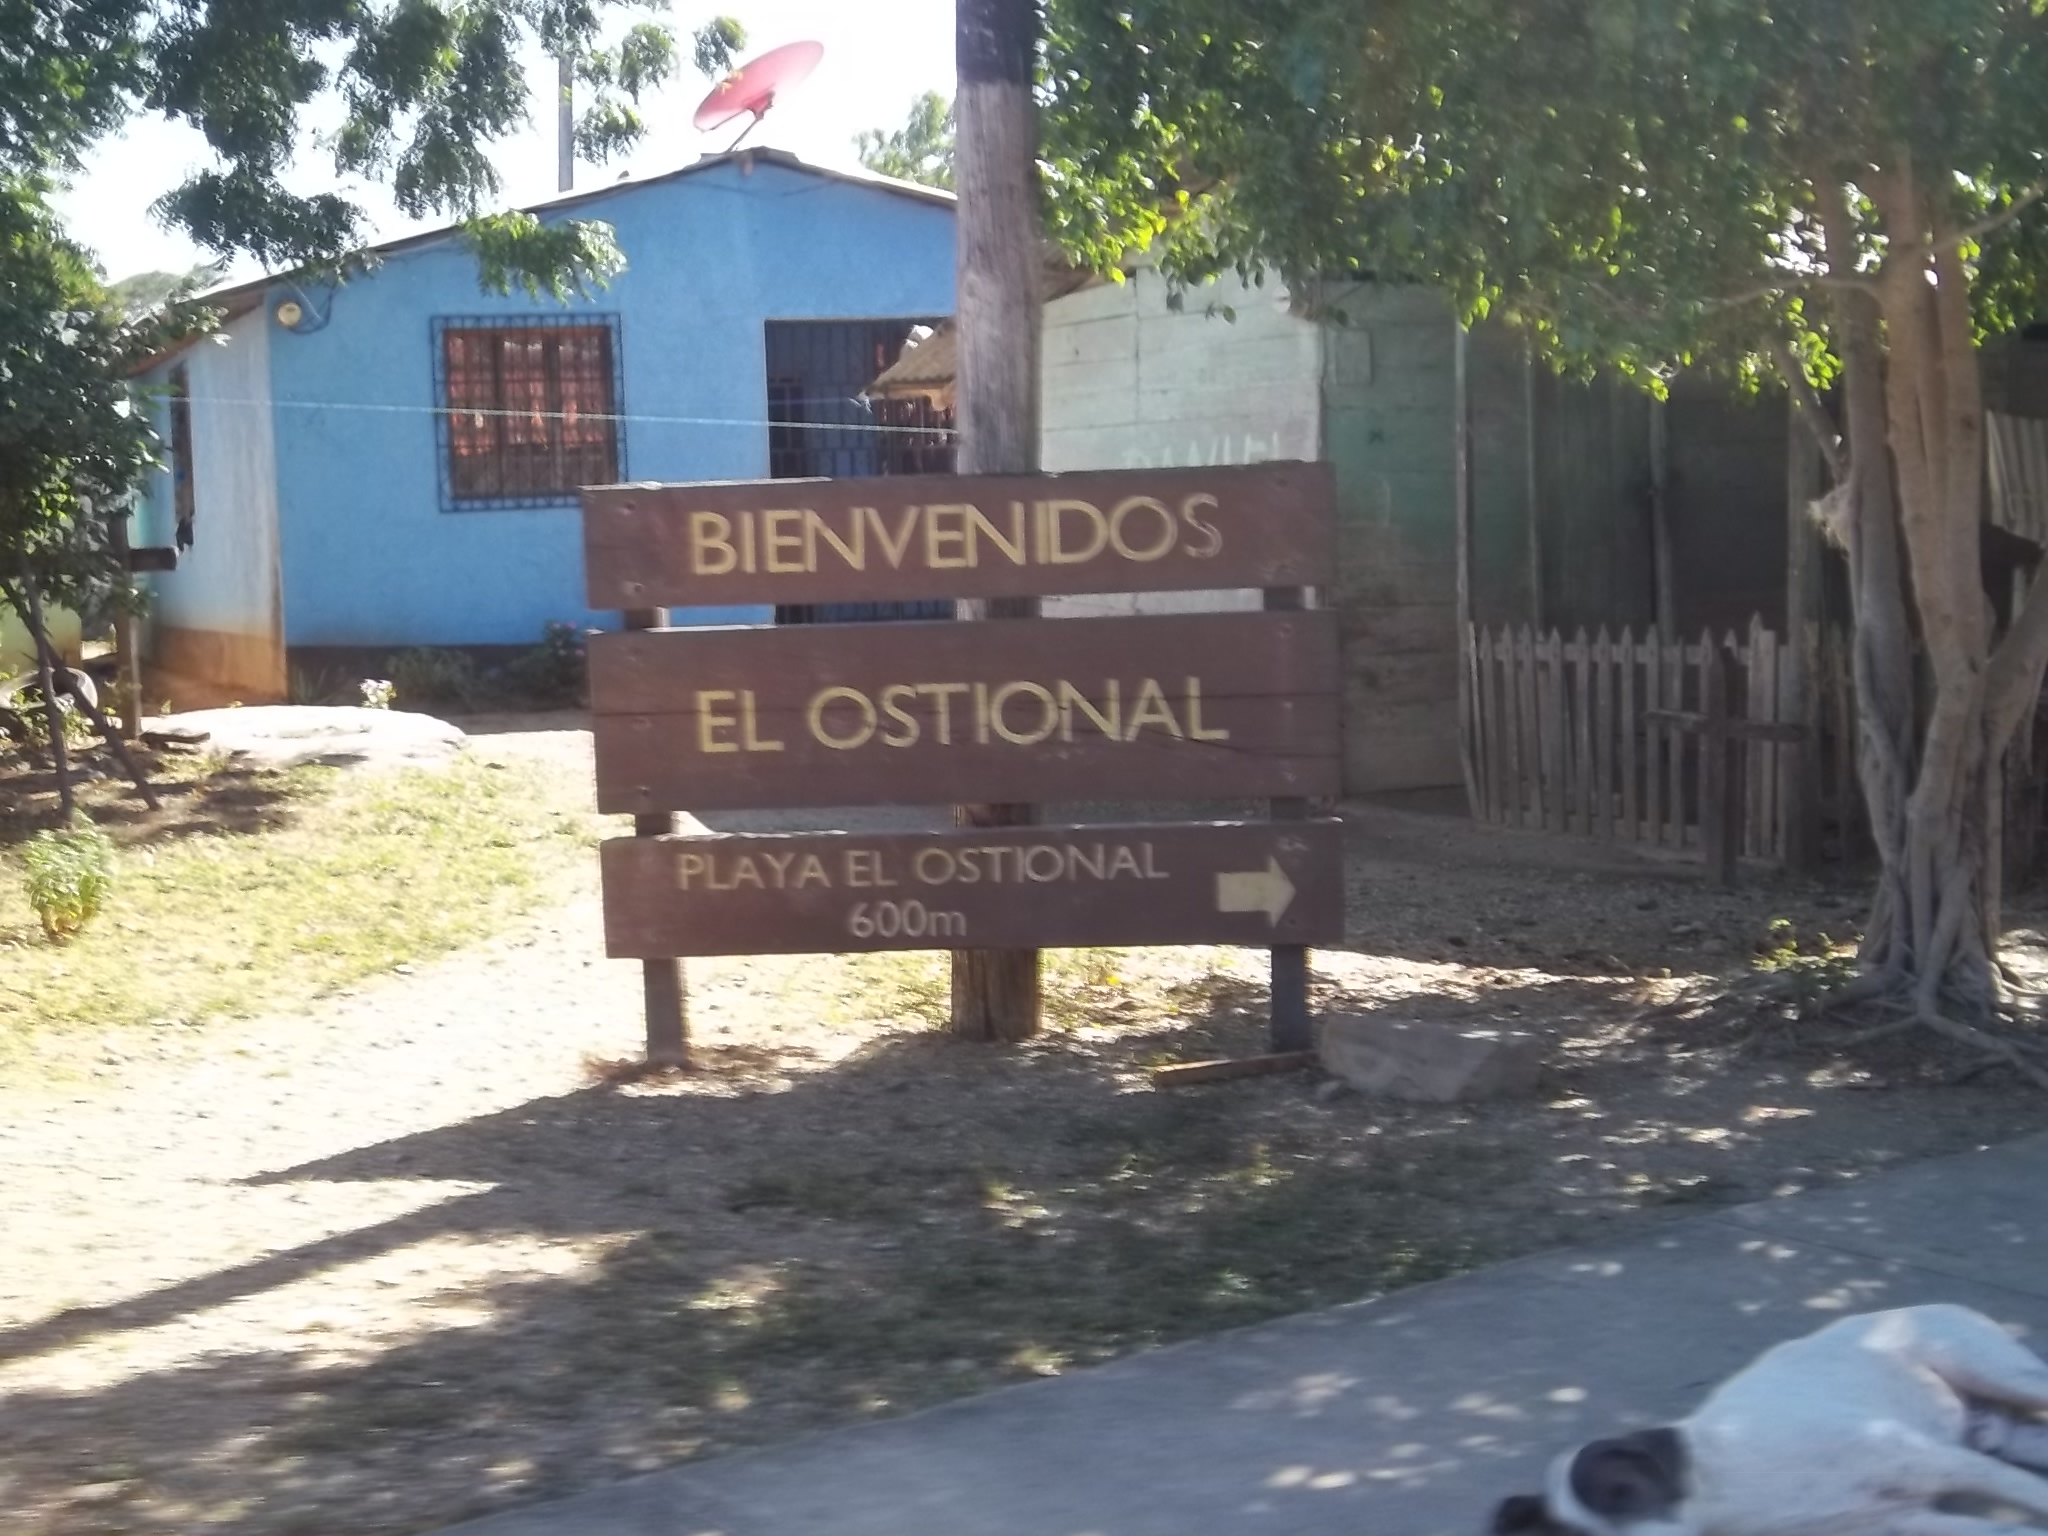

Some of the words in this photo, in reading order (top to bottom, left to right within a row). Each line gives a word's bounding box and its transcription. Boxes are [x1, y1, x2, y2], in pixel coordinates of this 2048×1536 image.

[689, 492, 1223, 575] BIENVENIDOS
[695, 689, 785, 753] EL
[807, 676, 1230, 751] OSTIONAL
[678, 852, 832, 891] PLAYA
[845, 850, 898, 888] EL
[914, 841, 1170, 885] OSTIONAL
[848, 900, 968, 939] 600m
